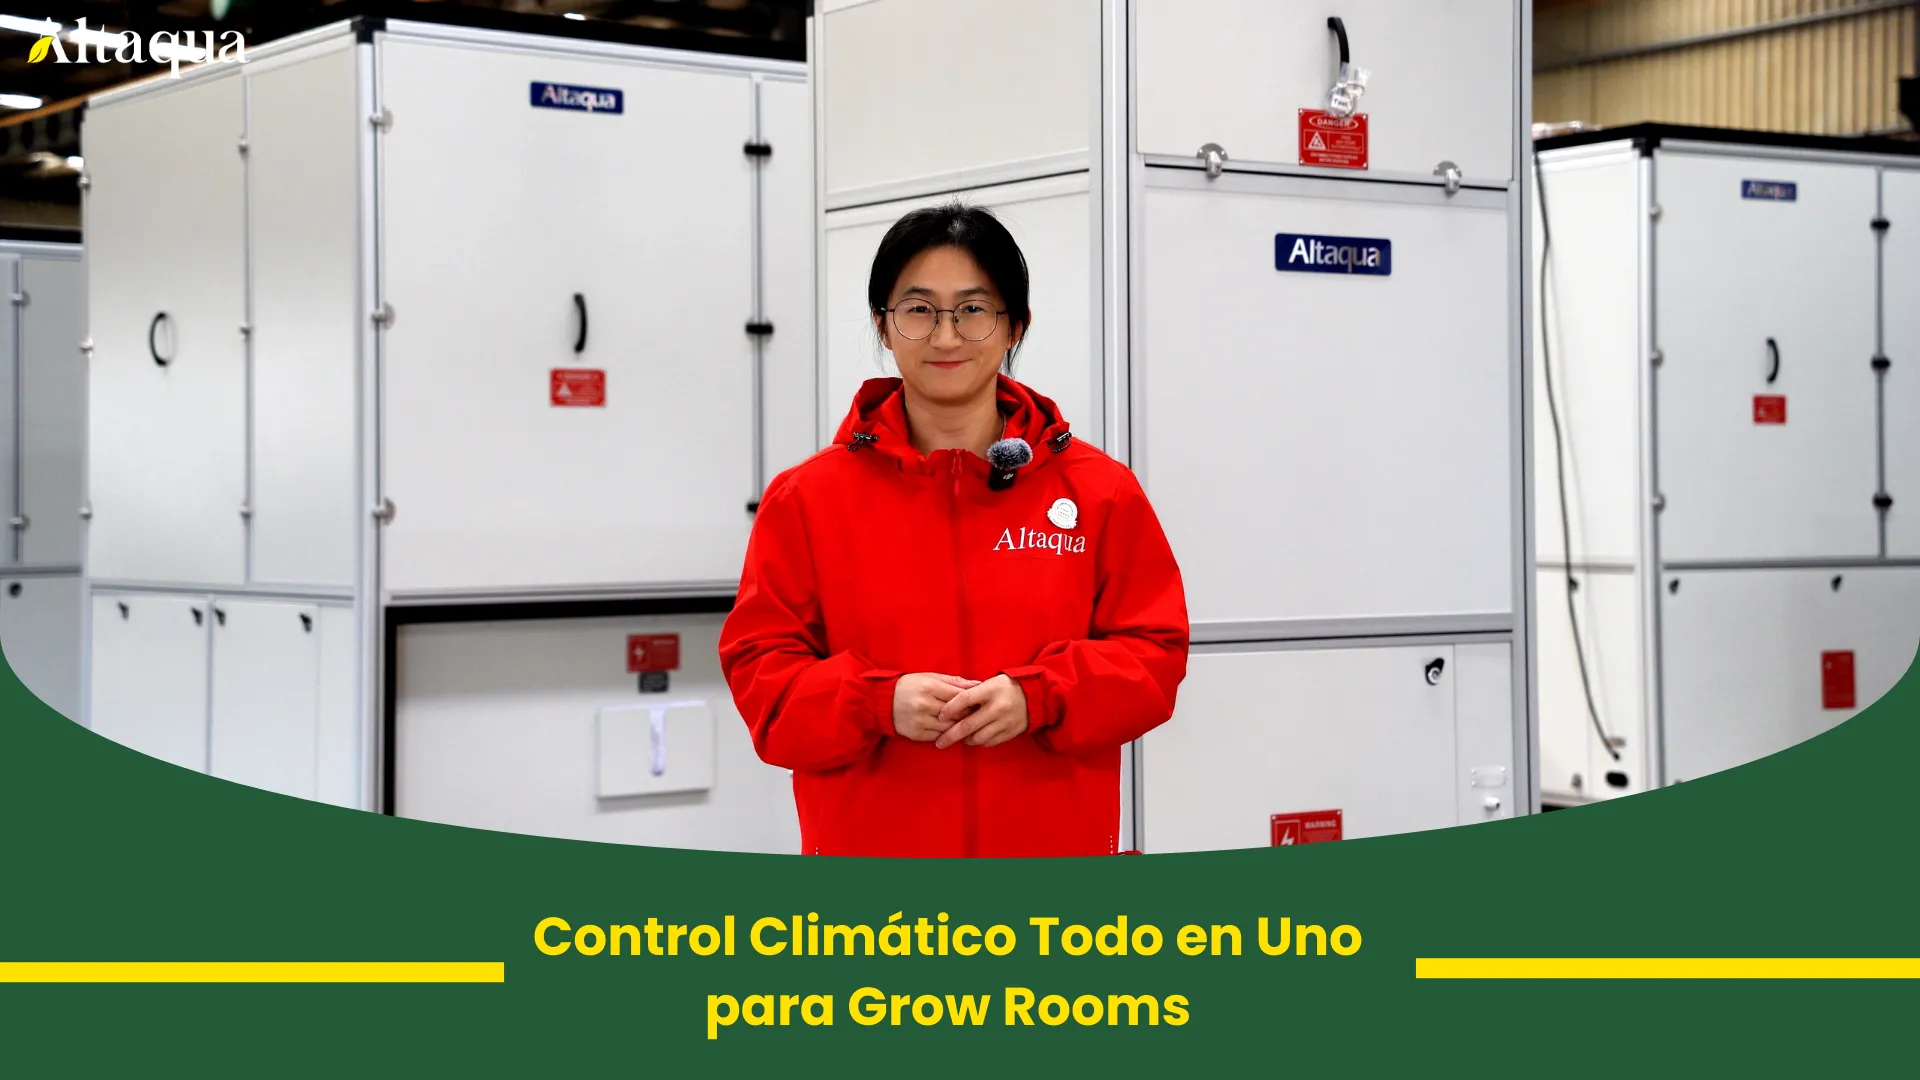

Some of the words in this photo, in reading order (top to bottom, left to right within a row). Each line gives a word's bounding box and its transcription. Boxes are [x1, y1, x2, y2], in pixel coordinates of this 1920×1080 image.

[541, 83, 616, 112] Altaqua
[1288, 238, 1381, 273] Altaqua
[992, 527, 1086, 555] Altaqua
